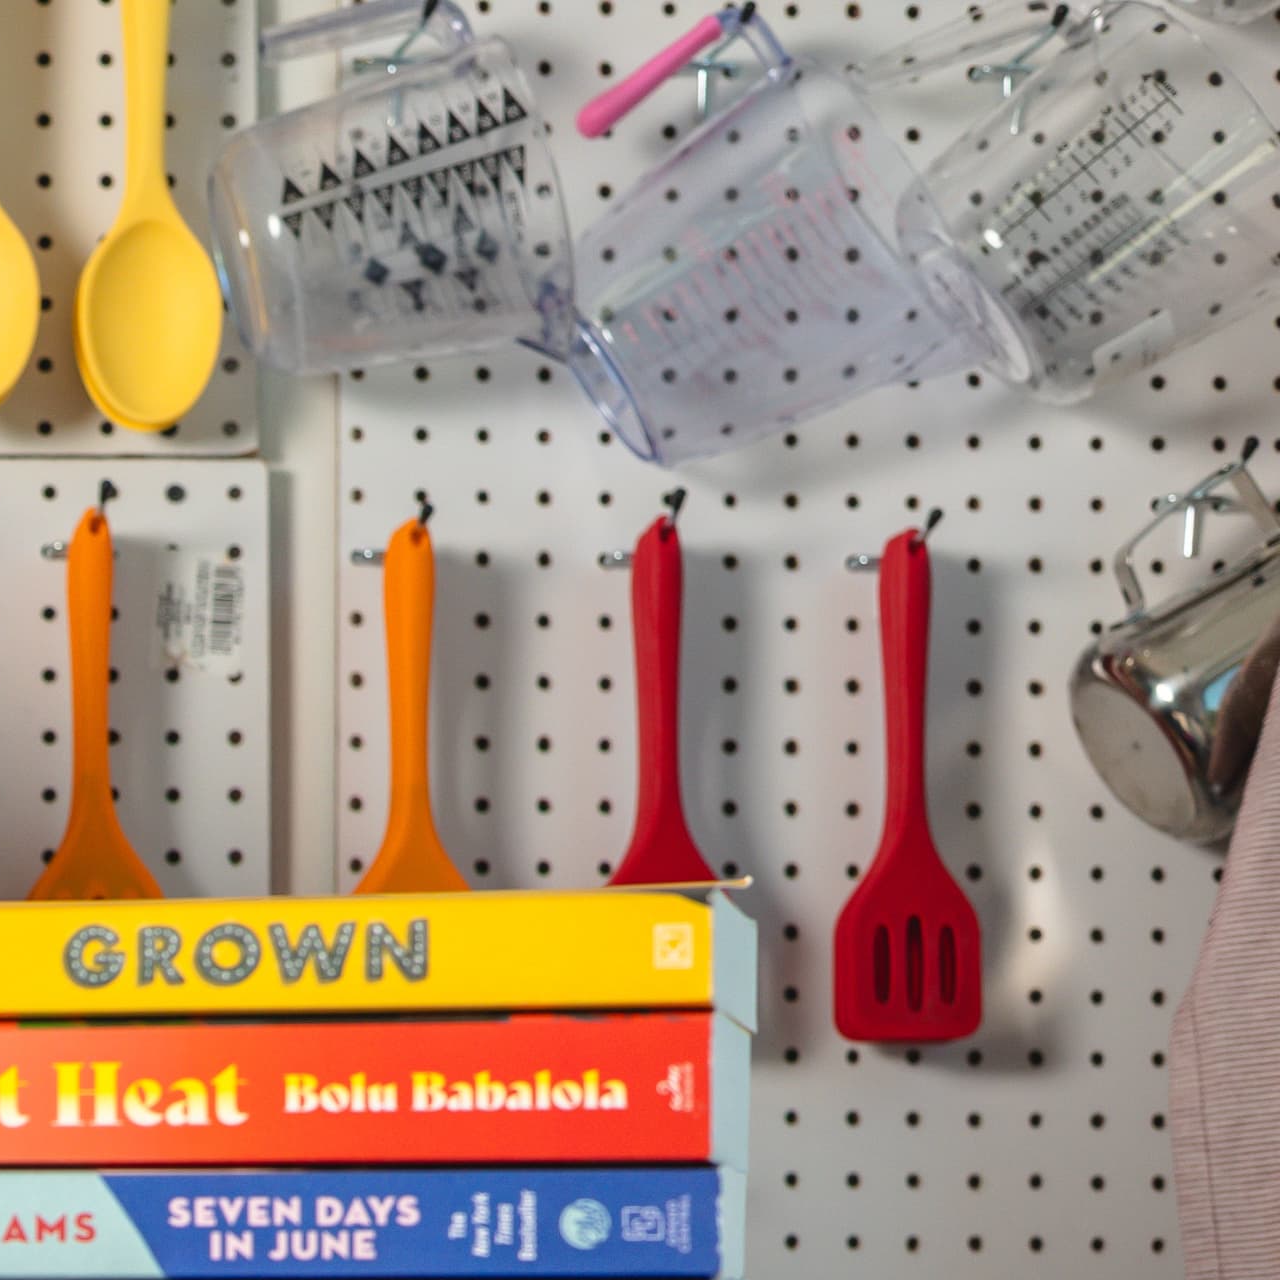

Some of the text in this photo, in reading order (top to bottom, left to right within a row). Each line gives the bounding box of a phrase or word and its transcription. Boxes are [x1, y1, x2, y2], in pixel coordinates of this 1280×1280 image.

[62, 918, 430, 989] GROWN
[51, 1060, 250, 1128] Heat
[283, 1071, 397, 1113] Bolu
[410, 1068, 629, 1112] Babalola
[167, 1195, 421, 1228] SEVEN DAYS
[209, 1230, 377, 1261] IN JUNE
